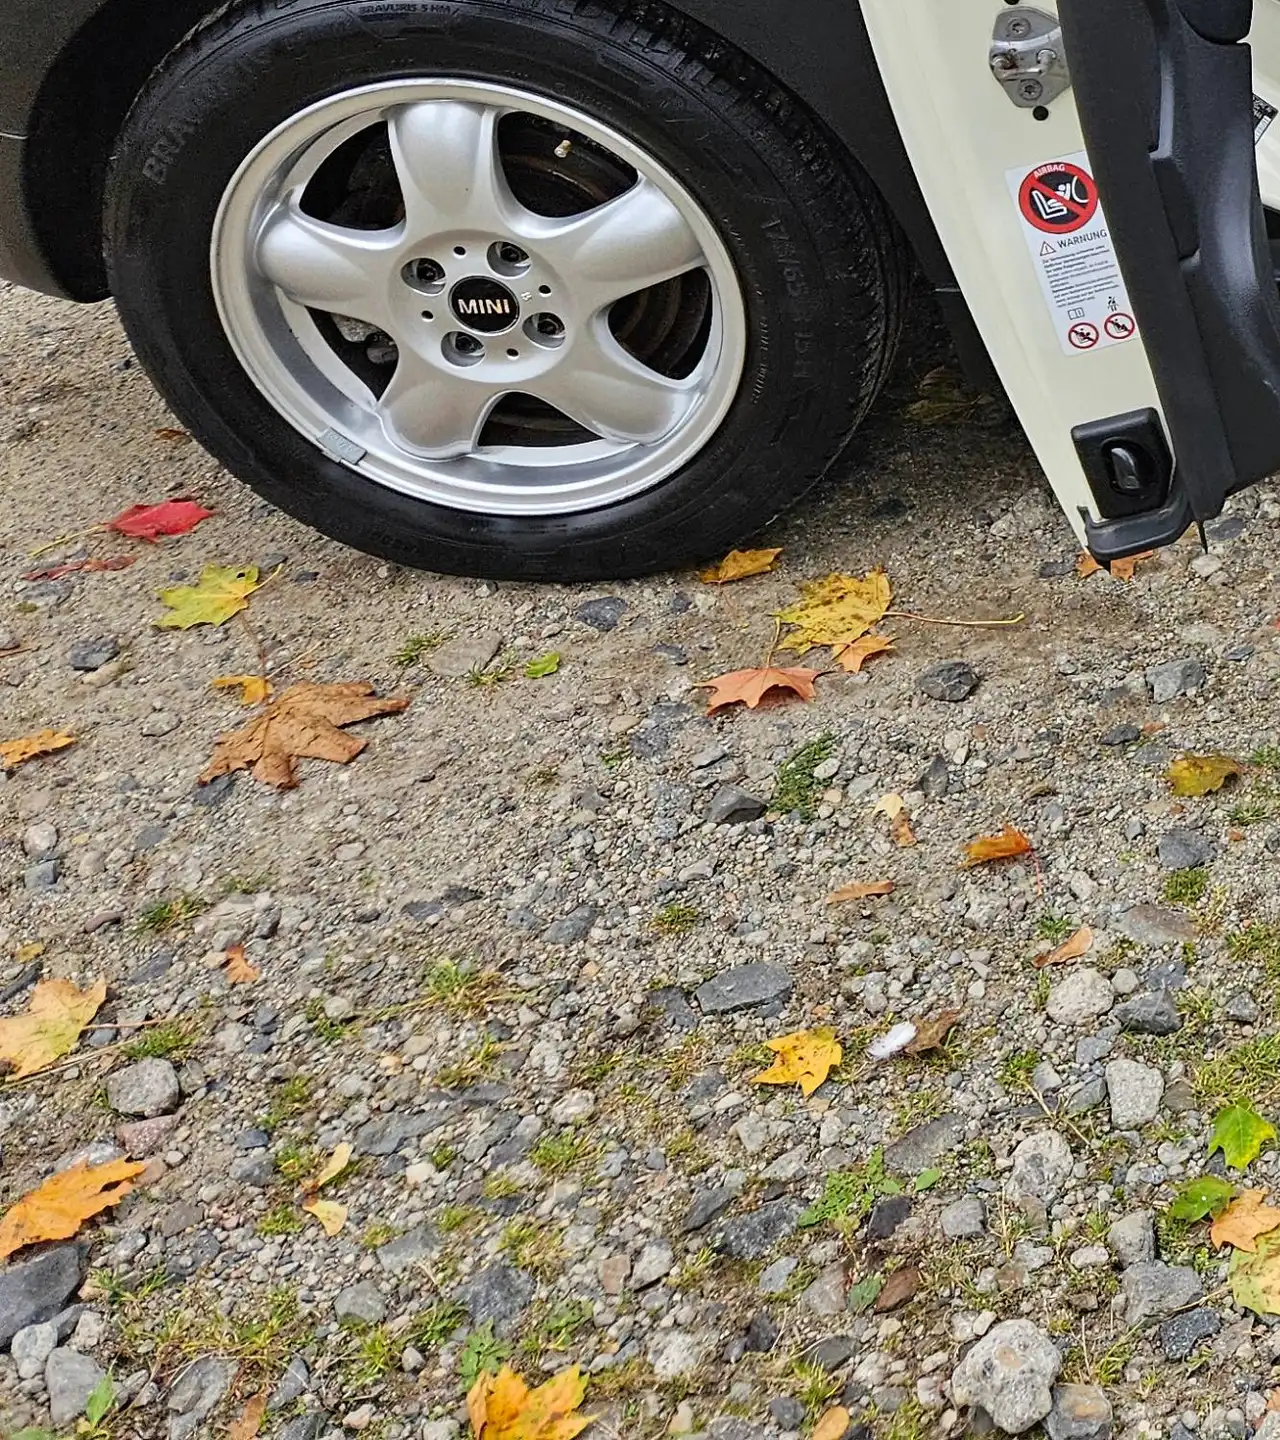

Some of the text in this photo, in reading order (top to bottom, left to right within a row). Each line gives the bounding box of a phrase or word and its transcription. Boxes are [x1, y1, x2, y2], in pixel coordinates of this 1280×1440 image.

[1033, 163, 1066, 178] AIRBAG
[1057, 228, 1108, 249] WARNUNG
[457, 298, 511, 314] MINI
